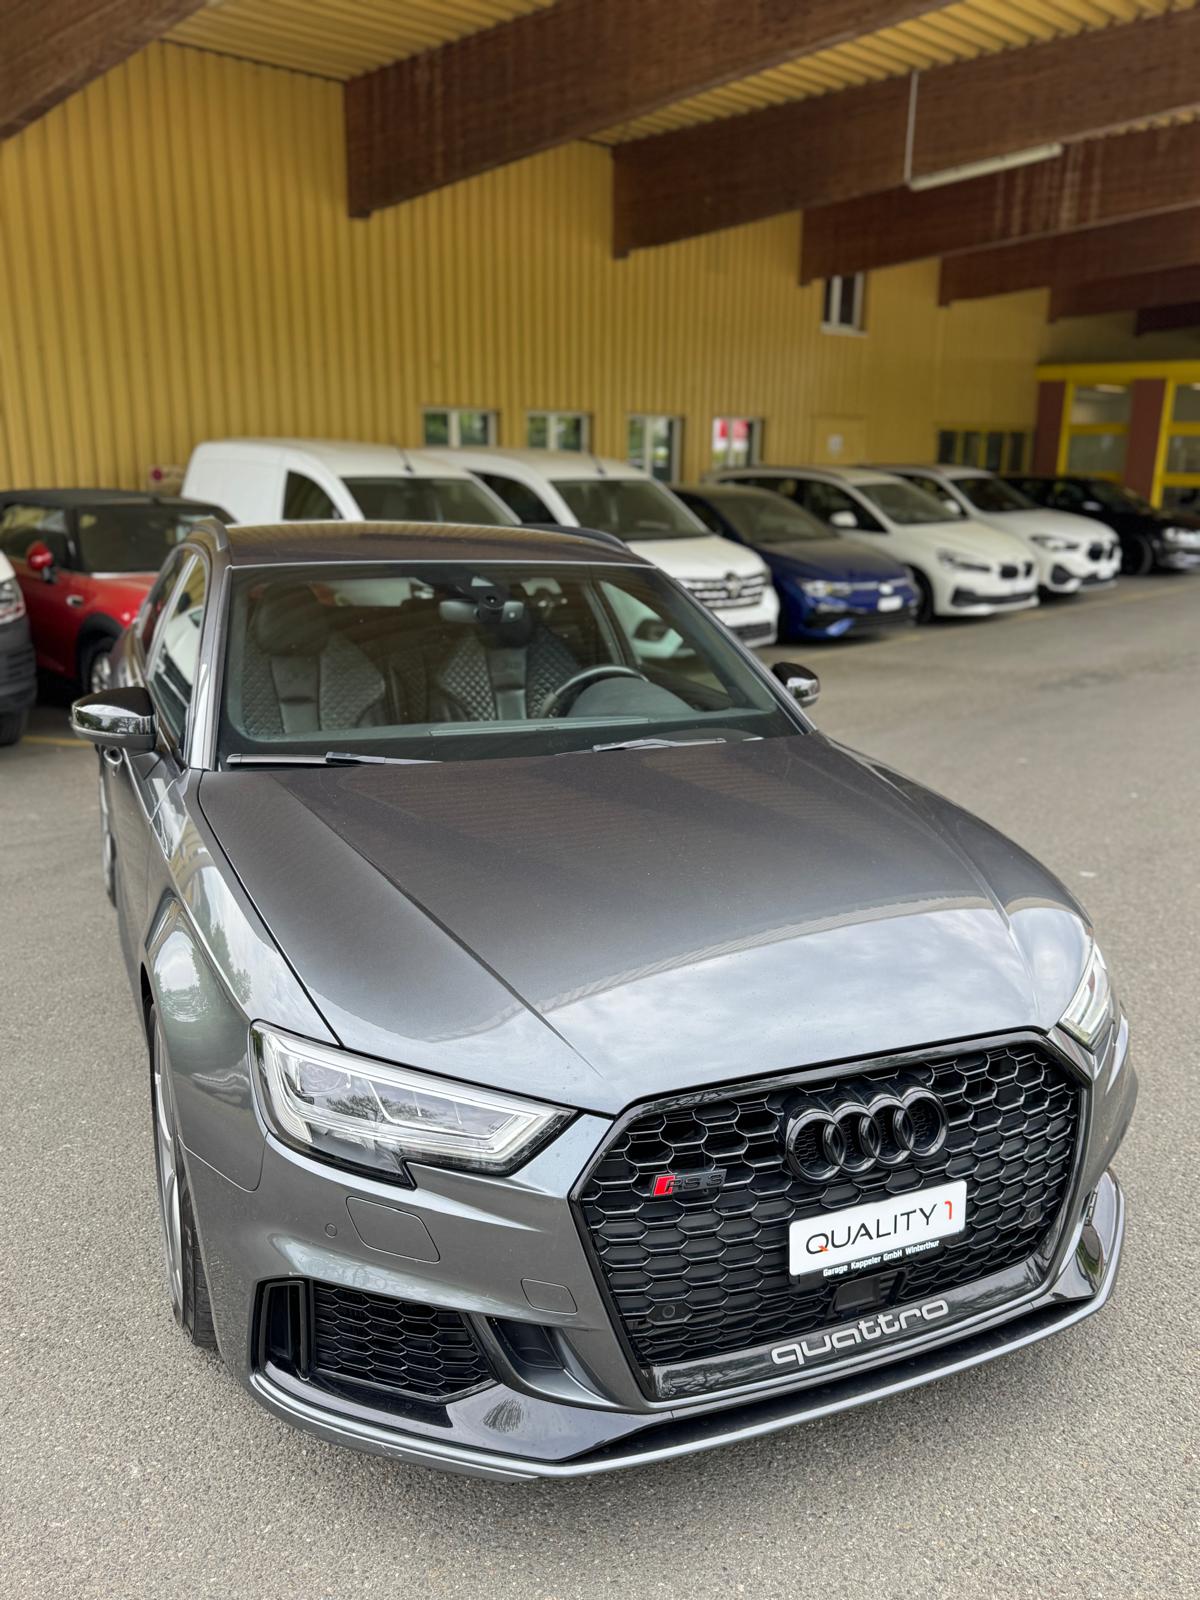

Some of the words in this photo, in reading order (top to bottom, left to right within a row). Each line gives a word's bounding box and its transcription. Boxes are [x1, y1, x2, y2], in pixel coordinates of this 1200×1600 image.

[805, 1203, 938, 1255] QUALITY
[944, 1200, 953, 1220] 1
[823, 1265, 848, 1277] Garage
[851, 1256, 881, 1269] Kappeler
[883, 1249, 903, 1262] GmbH
[905, 1240, 940, 1256] Winterthur
[771, 1300, 949, 1365] quattro
